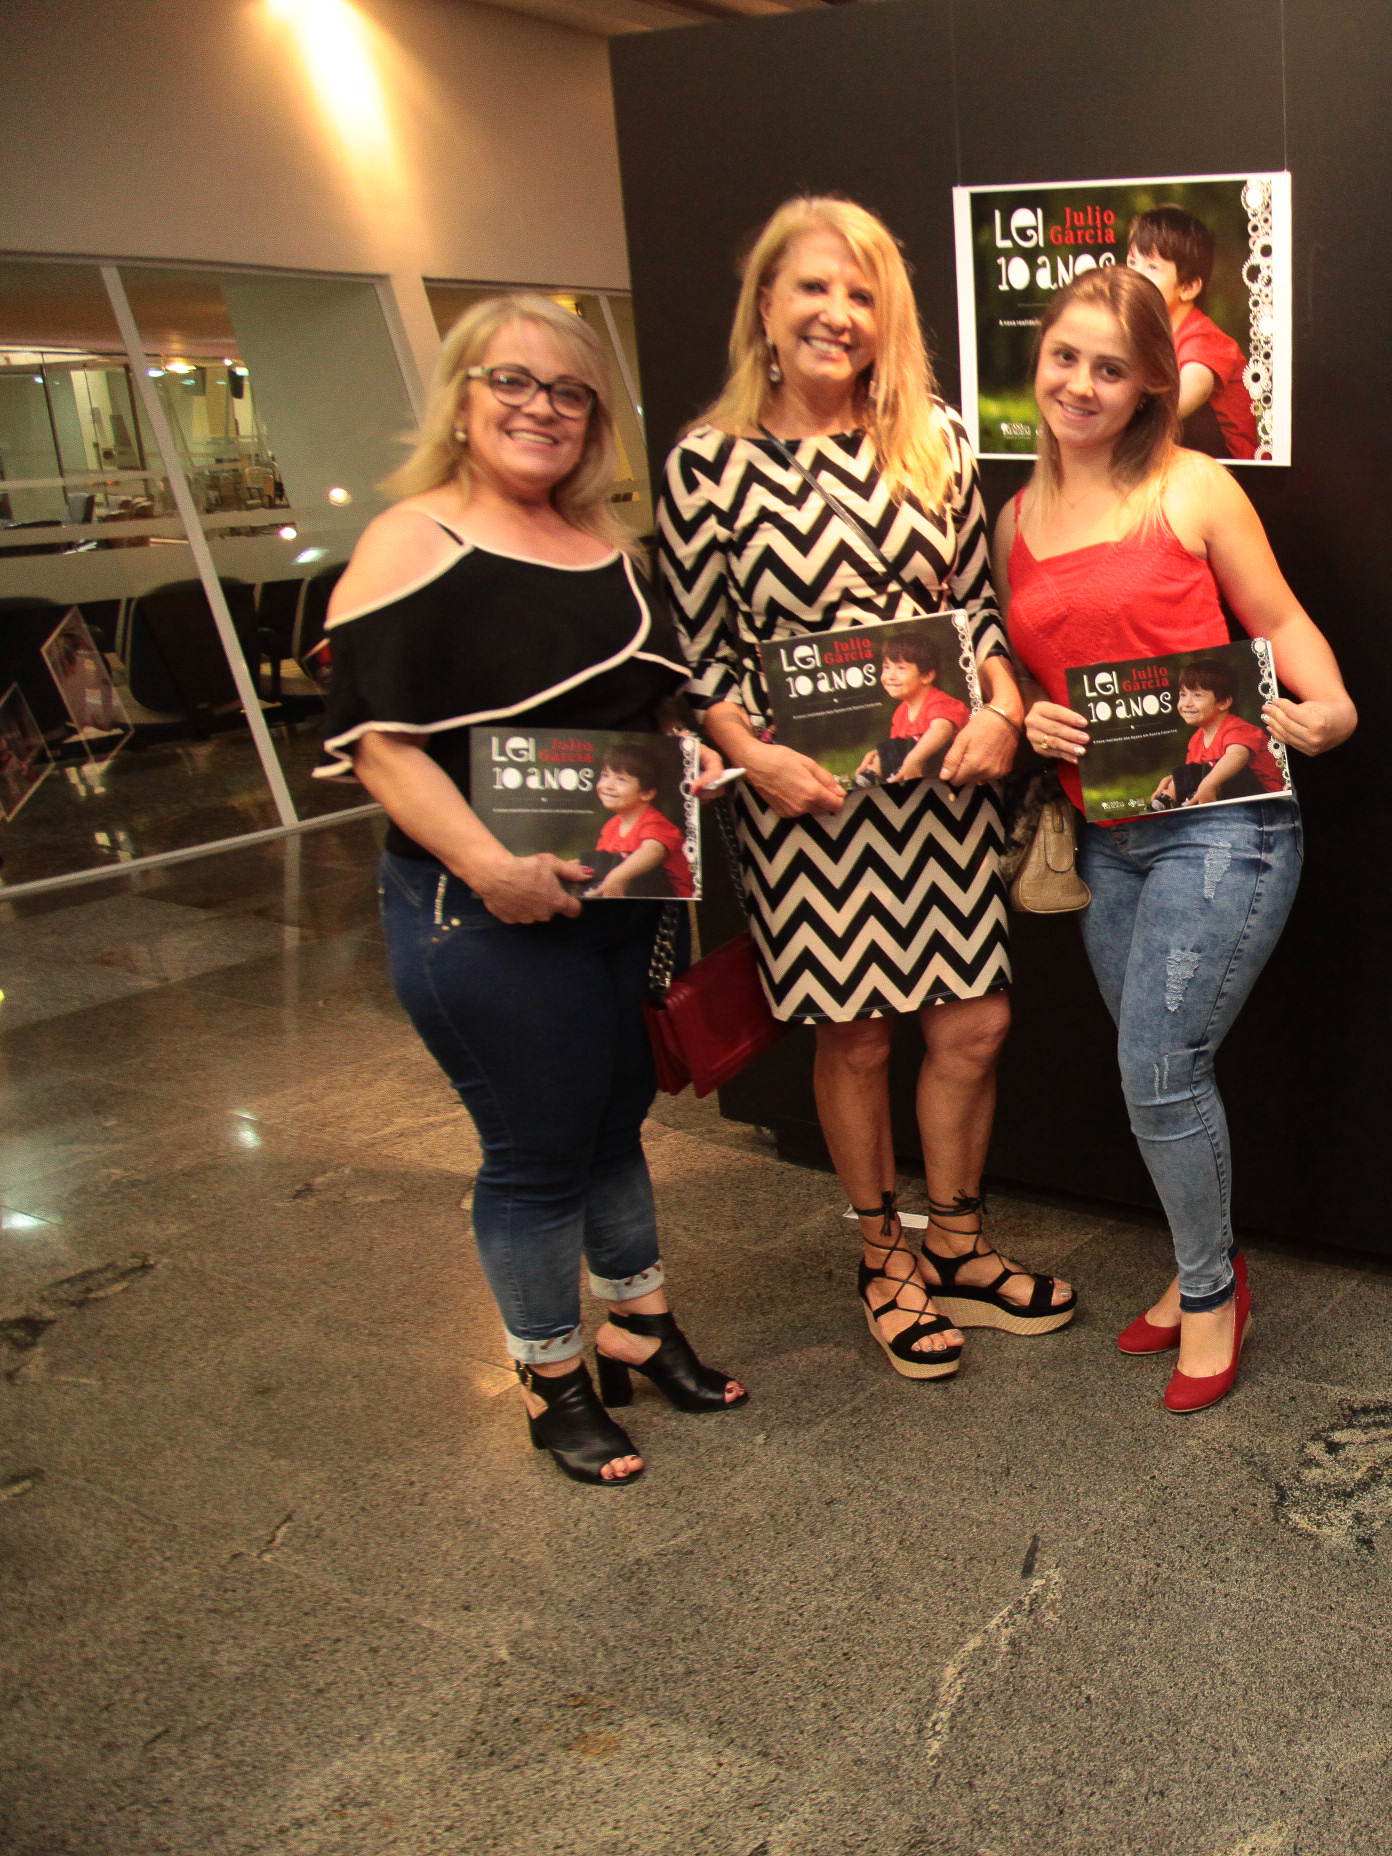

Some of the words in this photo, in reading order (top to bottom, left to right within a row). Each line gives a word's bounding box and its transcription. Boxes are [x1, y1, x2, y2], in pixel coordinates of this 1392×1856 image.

[1064, 206, 1116, 228] Julio
[1050, 225, 1116, 245] Garcia
[997, 256, 1030, 291] 10
[833, 637, 873, 653] Julio
[823, 648, 874, 665] Garcia
[1122, 677, 1171, 692] Garcia
[1131, 667, 1168, 681] Julio
[785, 675, 814, 699] 10
[1087, 701, 1112, 723] 10
[492, 767, 523, 790] 10
